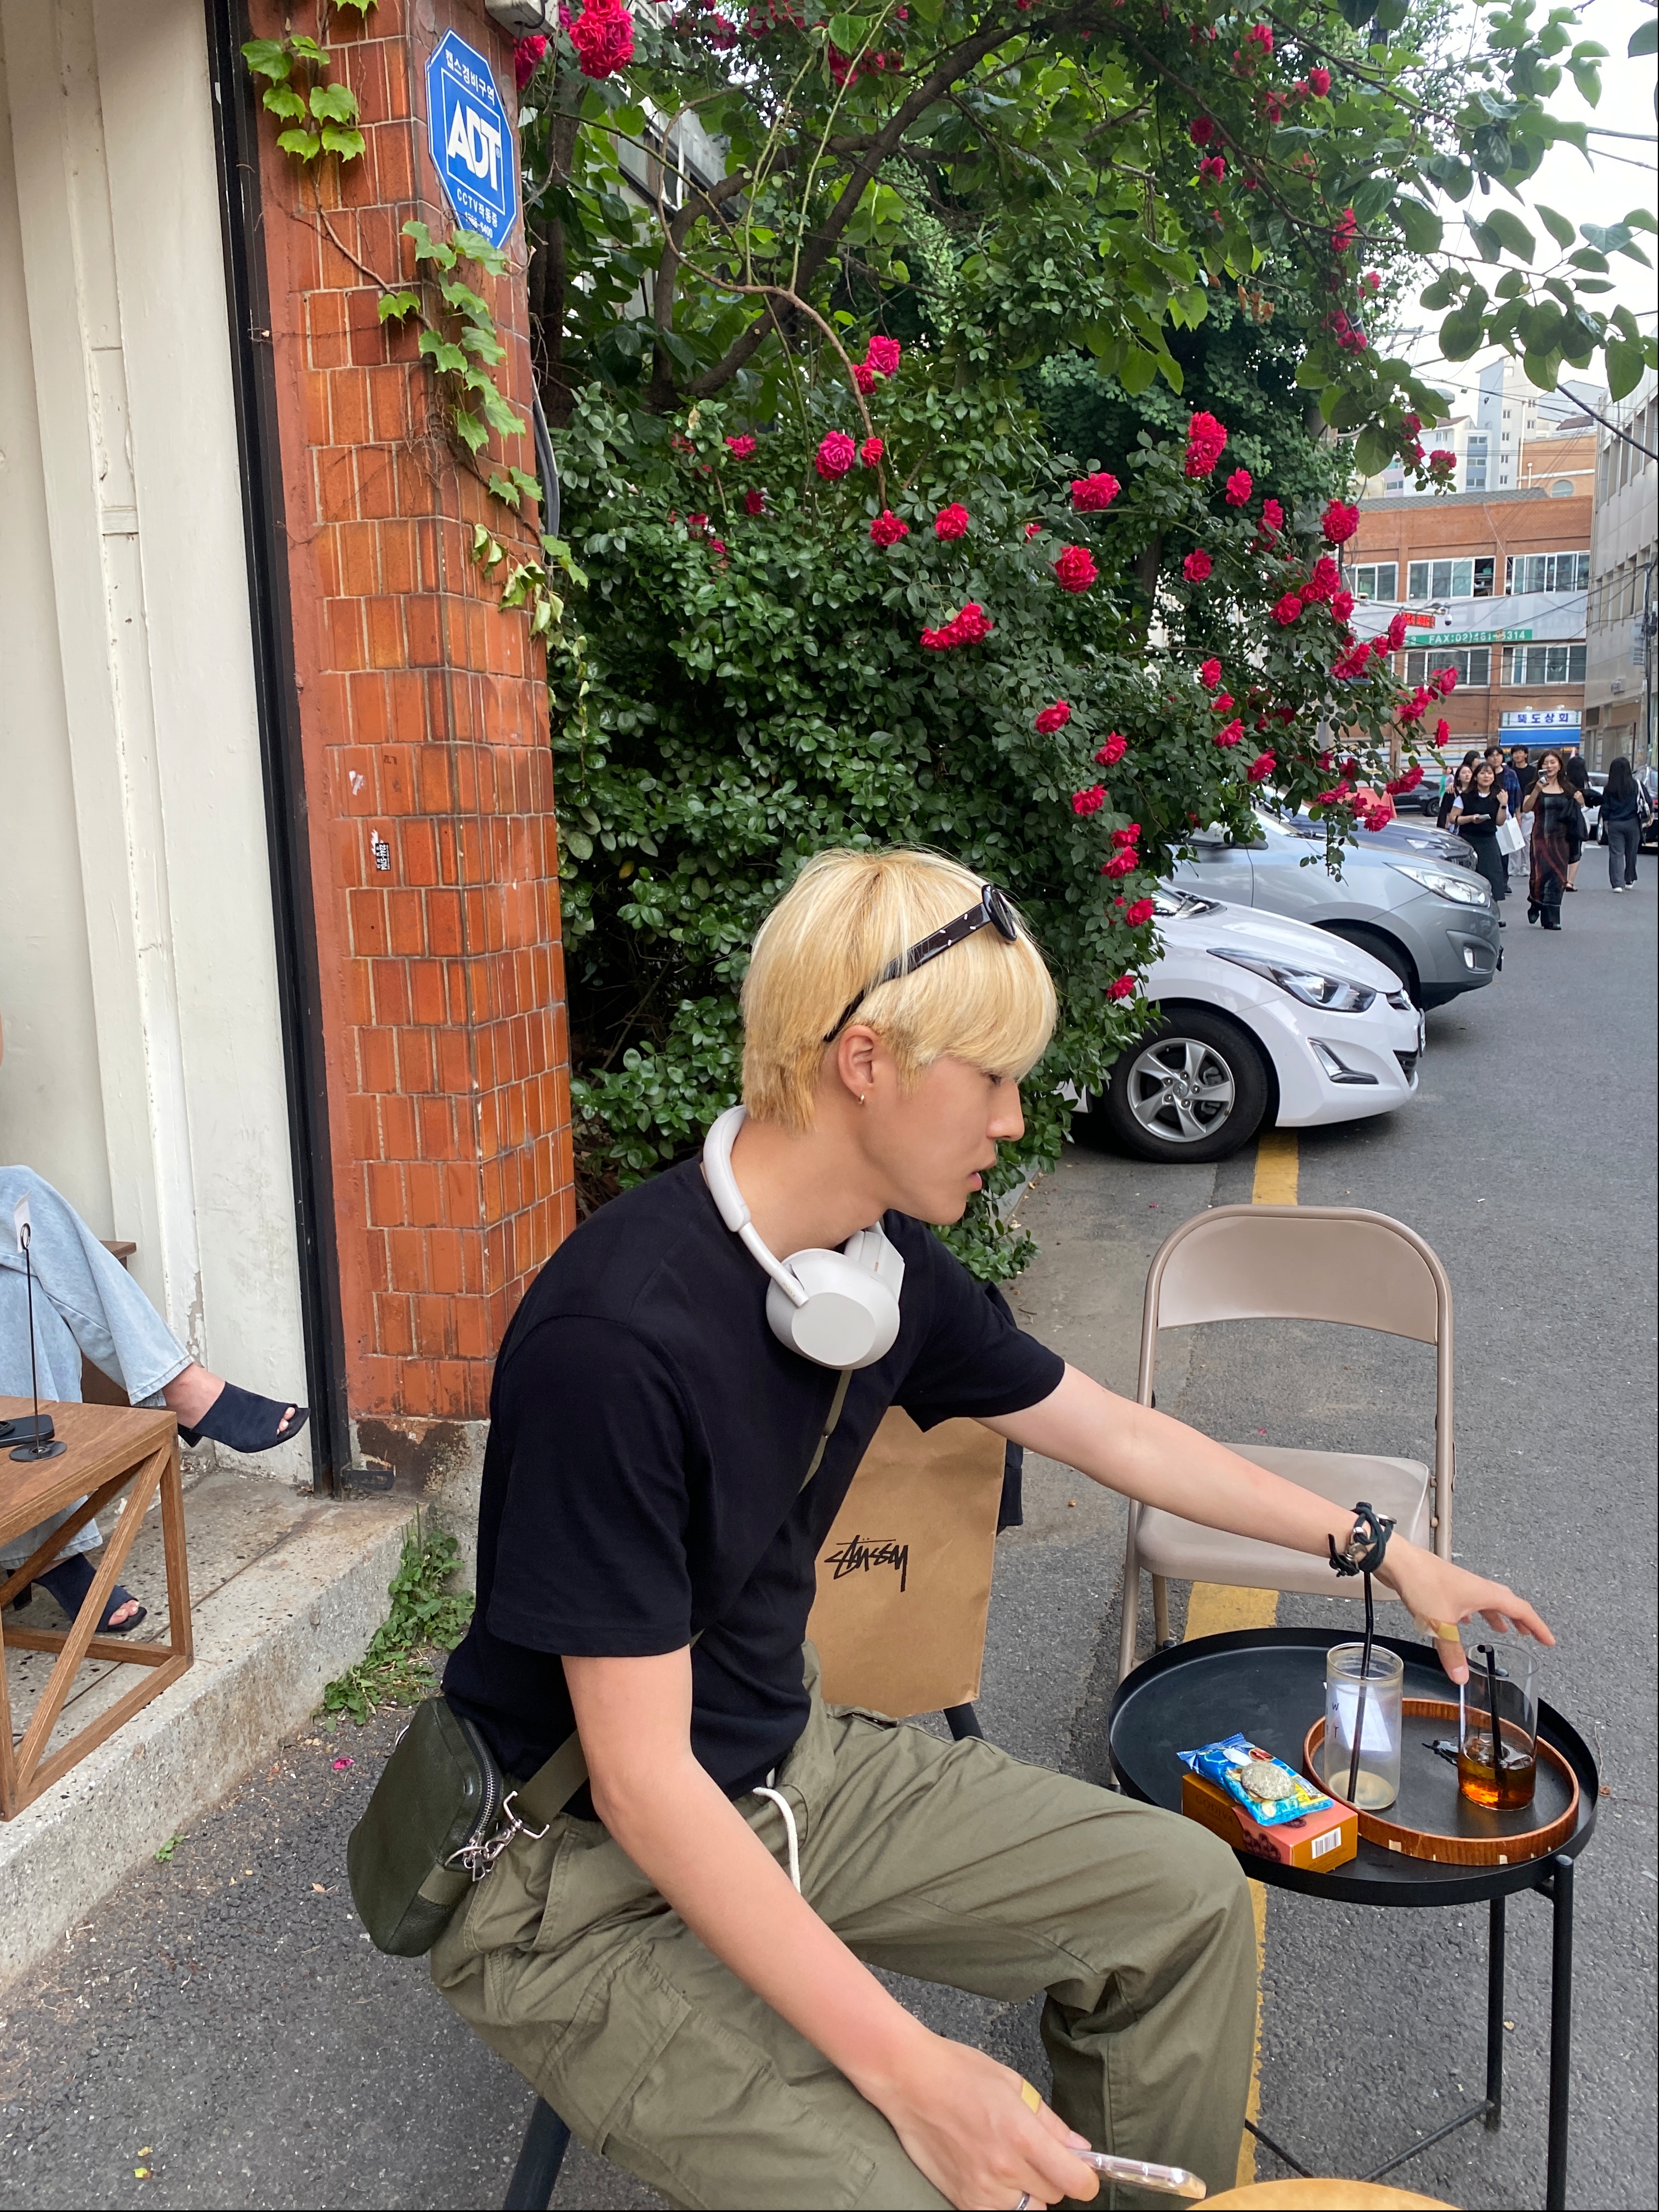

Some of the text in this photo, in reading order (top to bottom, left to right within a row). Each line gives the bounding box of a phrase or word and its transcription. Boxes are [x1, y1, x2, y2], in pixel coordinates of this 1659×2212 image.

[445, 49, 495, 106] 캡스경비구역
[447, 99, 501, 191] ADT
[1196, 1794, 1233, 1824] GODIVA
